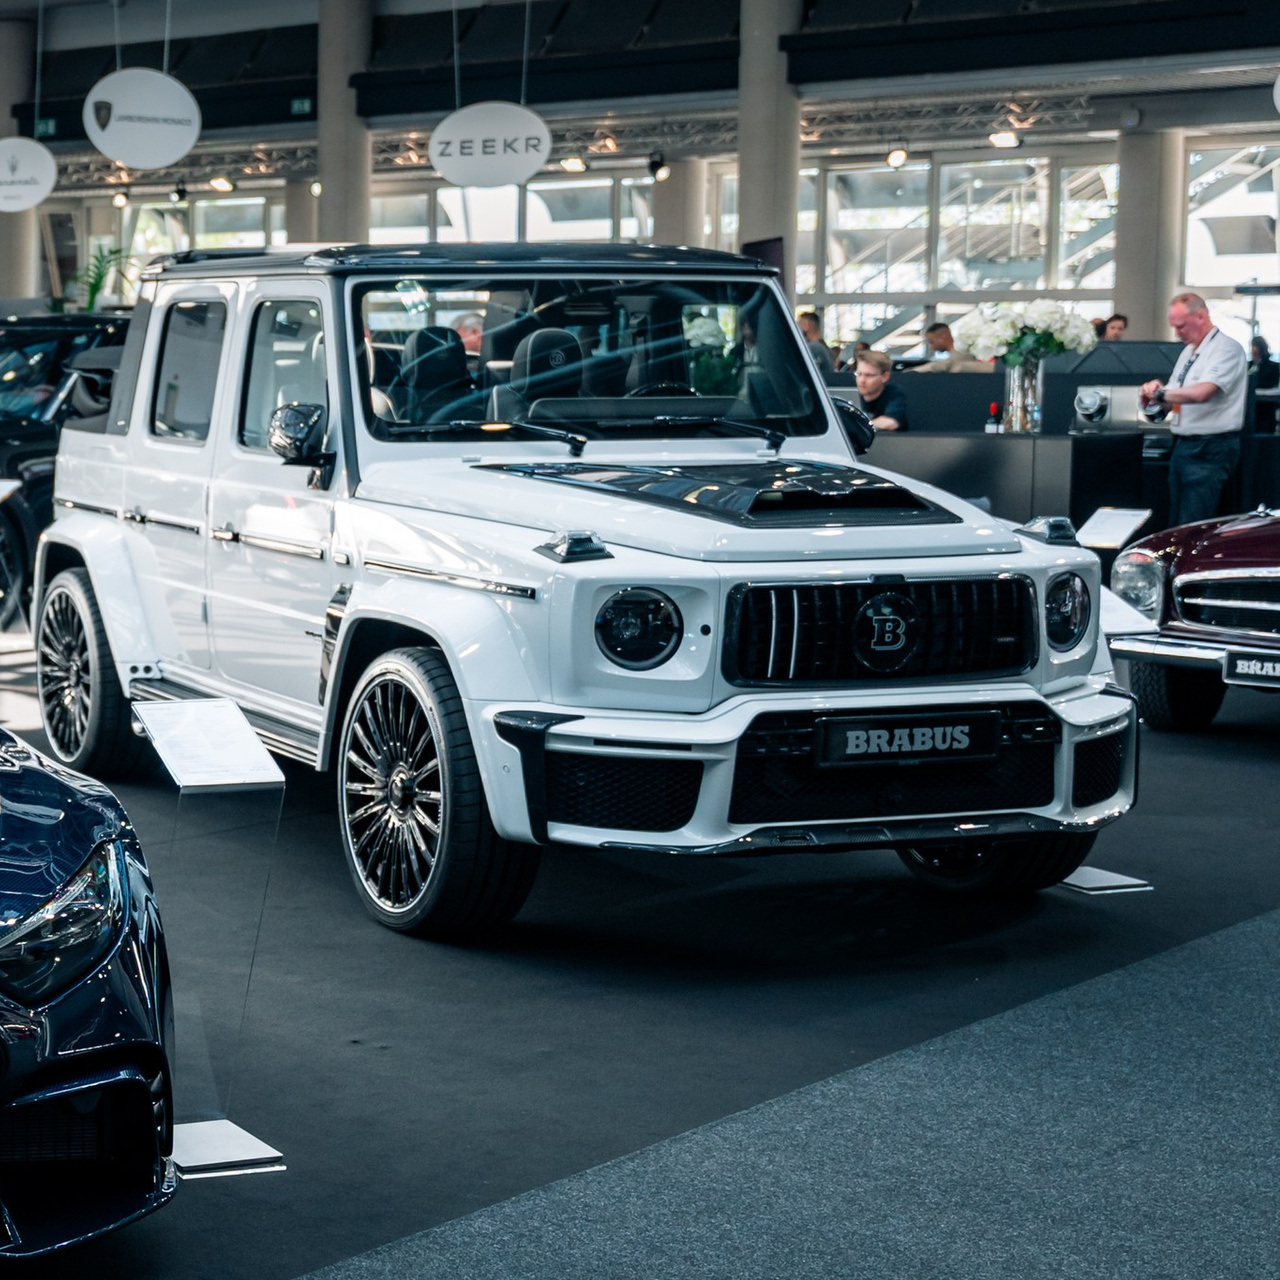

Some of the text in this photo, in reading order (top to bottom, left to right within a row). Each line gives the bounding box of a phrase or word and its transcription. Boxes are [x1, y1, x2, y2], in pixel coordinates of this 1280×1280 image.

[437, 137, 542, 157] ZEEKR
[871, 616, 906, 651] B
[846, 726, 970, 755] BRABUS
